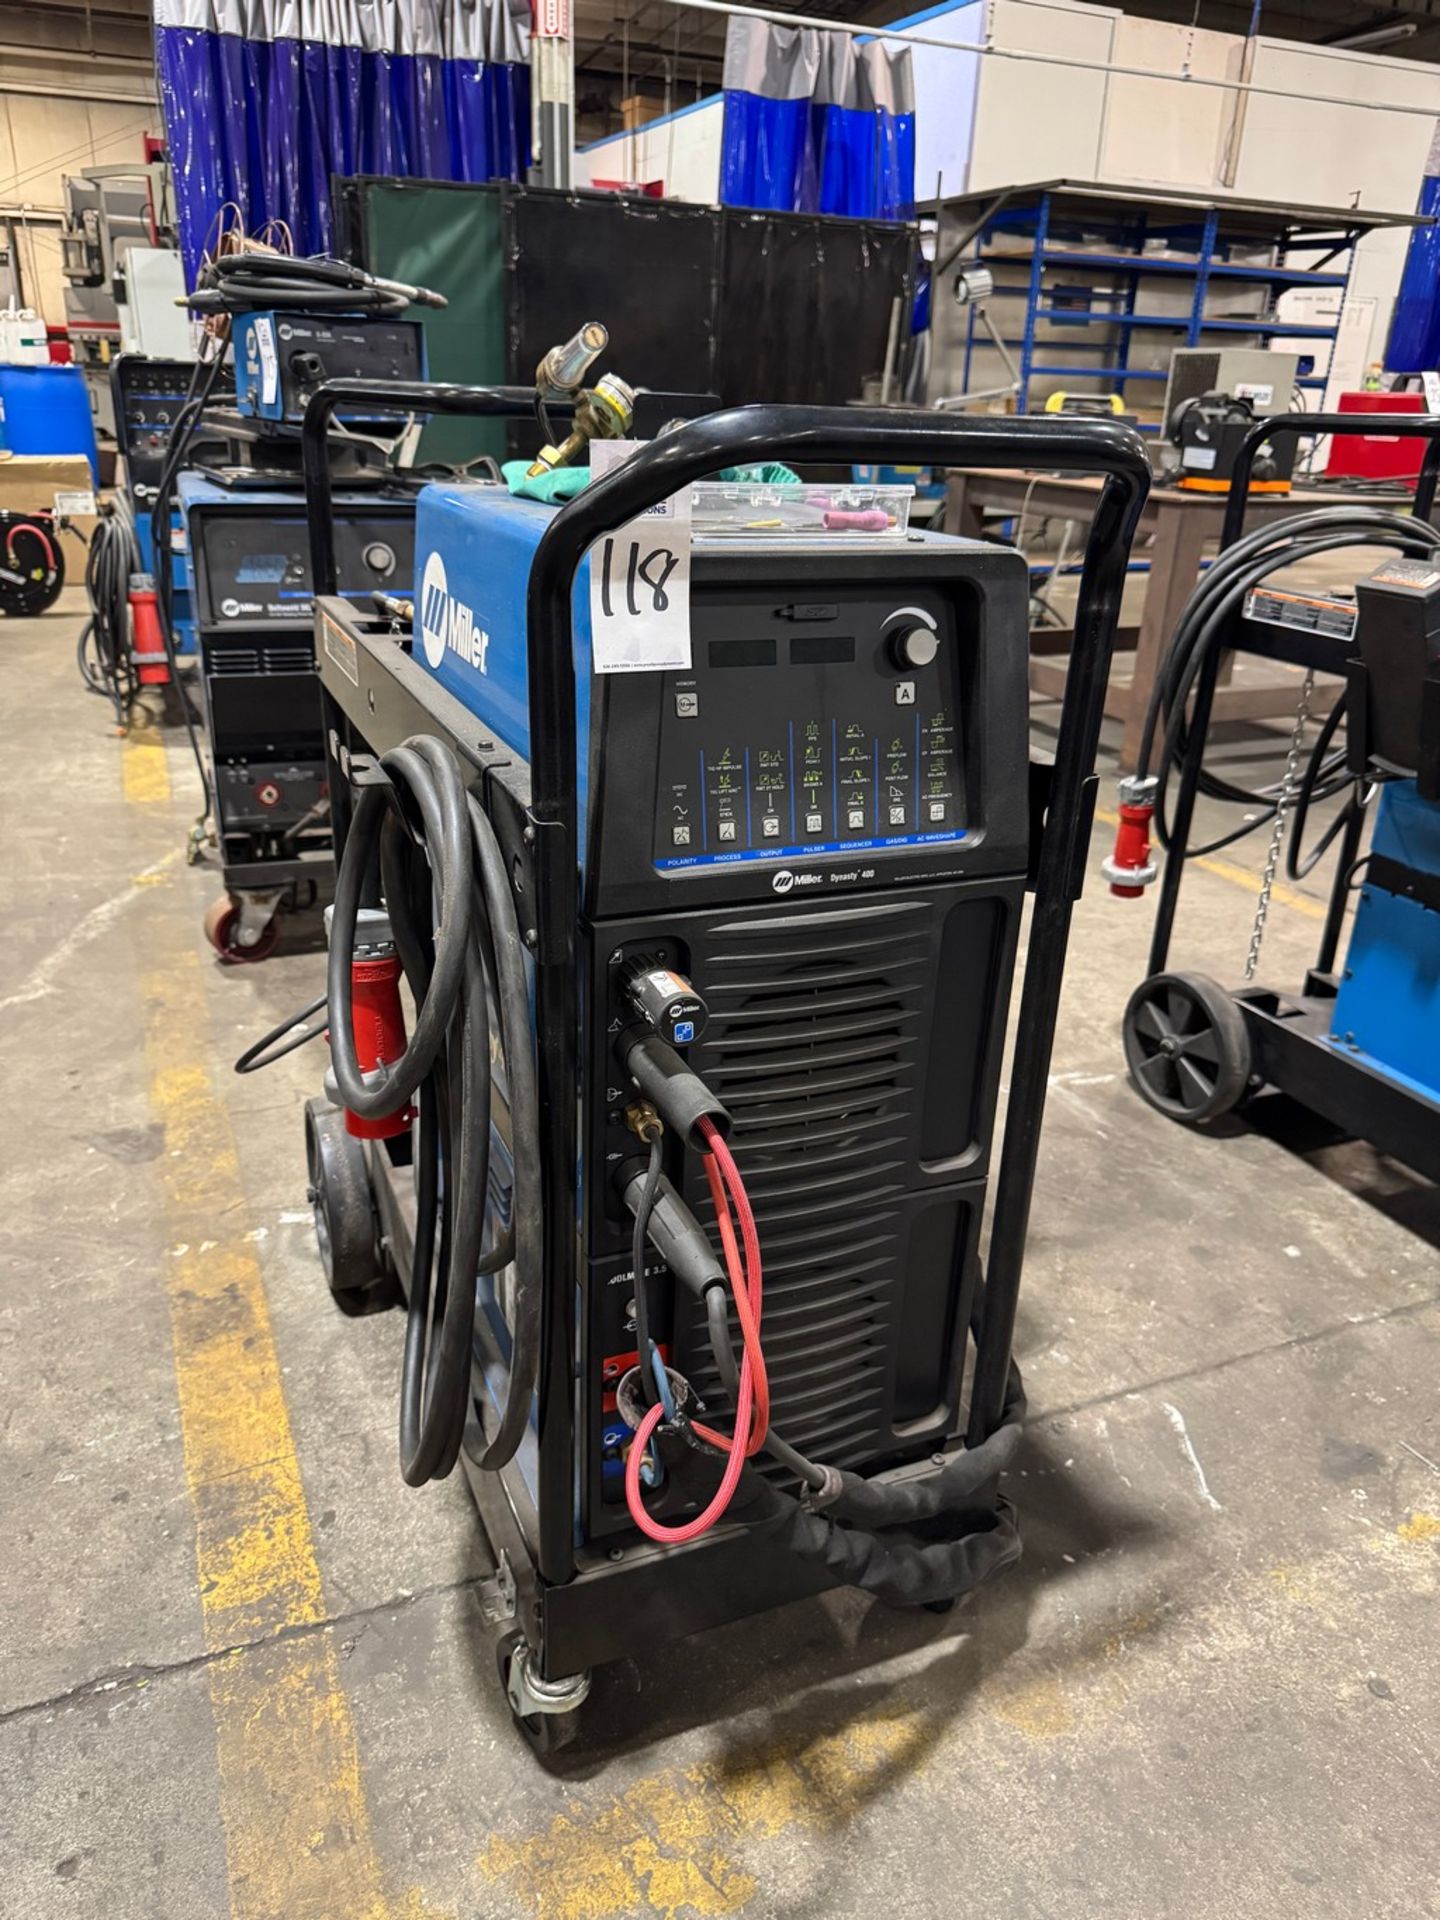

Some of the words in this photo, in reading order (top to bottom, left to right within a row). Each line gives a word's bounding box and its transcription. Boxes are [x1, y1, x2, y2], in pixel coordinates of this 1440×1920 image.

[602, 537, 679, 617] 118
[447, 596, 489, 677] Miller
[901, 688, 910, 700] A
[926, 832, 957, 841] WAVESHAPE
[803, 845, 825, 853] PULSER
[840, 840, 872, 849] SEQUENCER
[713, 853, 742, 862] PROCESS
[760, 849, 783, 857] OUTPUT
[667, 858, 697, 867] POLARITY
[794, 875, 822, 885] Miller
[861, 870, 875, 879] 400
[682, 1005, 700, 1013] Miller
